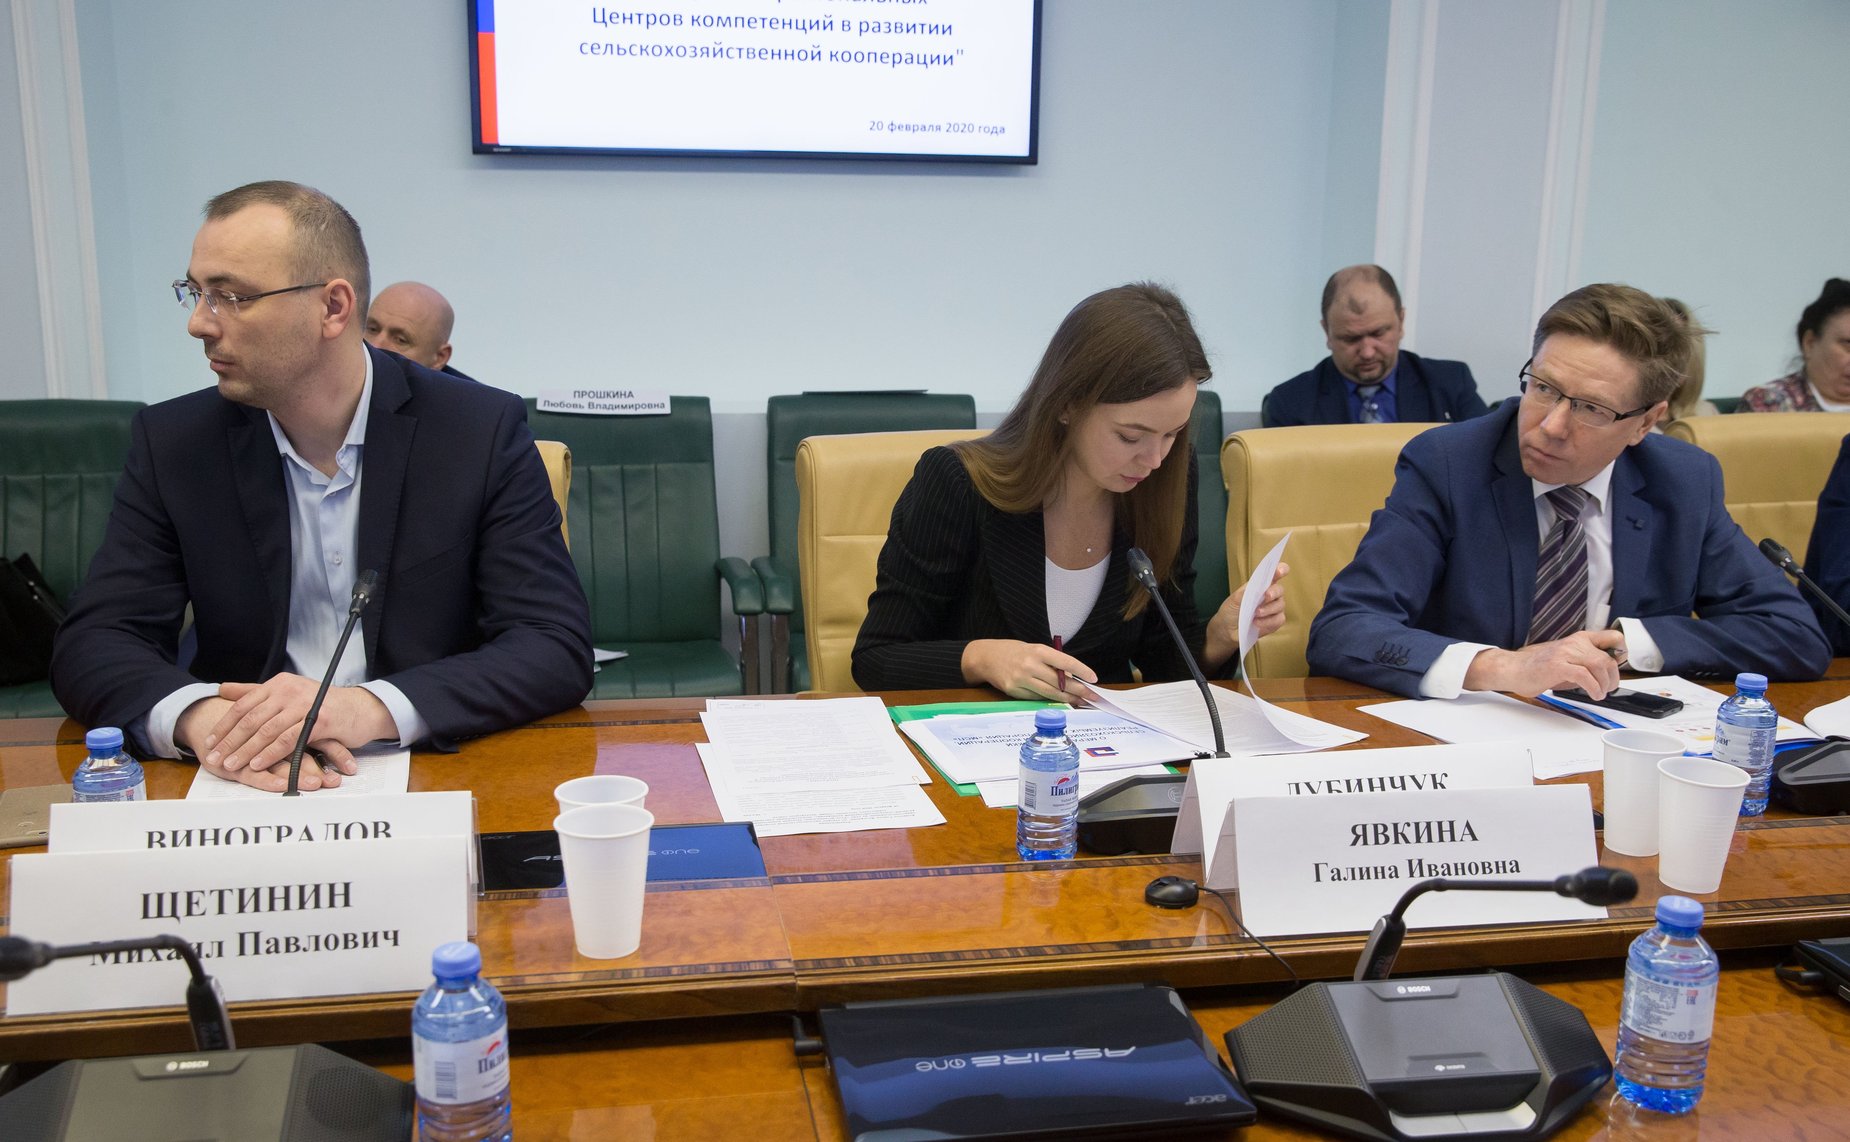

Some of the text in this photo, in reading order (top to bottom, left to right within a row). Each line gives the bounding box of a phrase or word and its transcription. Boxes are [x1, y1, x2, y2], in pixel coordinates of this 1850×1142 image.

[592, 7, 952, 36] Центров компетенций в развитии
[579, 41, 964, 68] сельскохозяйственной кооперации"
[869, 120, 1006, 135] 20 февраля 2020 года
[543, 400, 666, 411] Любовь Владимировна
[573, 390, 635, 399] ПРОШКИНА
[144, 821, 393, 849] ВИНОГРАДОВ
[1350, 819, 1480, 847] ЯВКИНА
[1312, 858, 1521, 883] Галина Ивановна
[140, 881, 353, 924] ЩЕТИНИН
[236, 929, 401, 957] Павлович
[1407, 985, 1431, 993] BOSCH
[971, 1046, 1136, 1068] ASPIRE
[1184, 1094, 1227, 1106] acer
